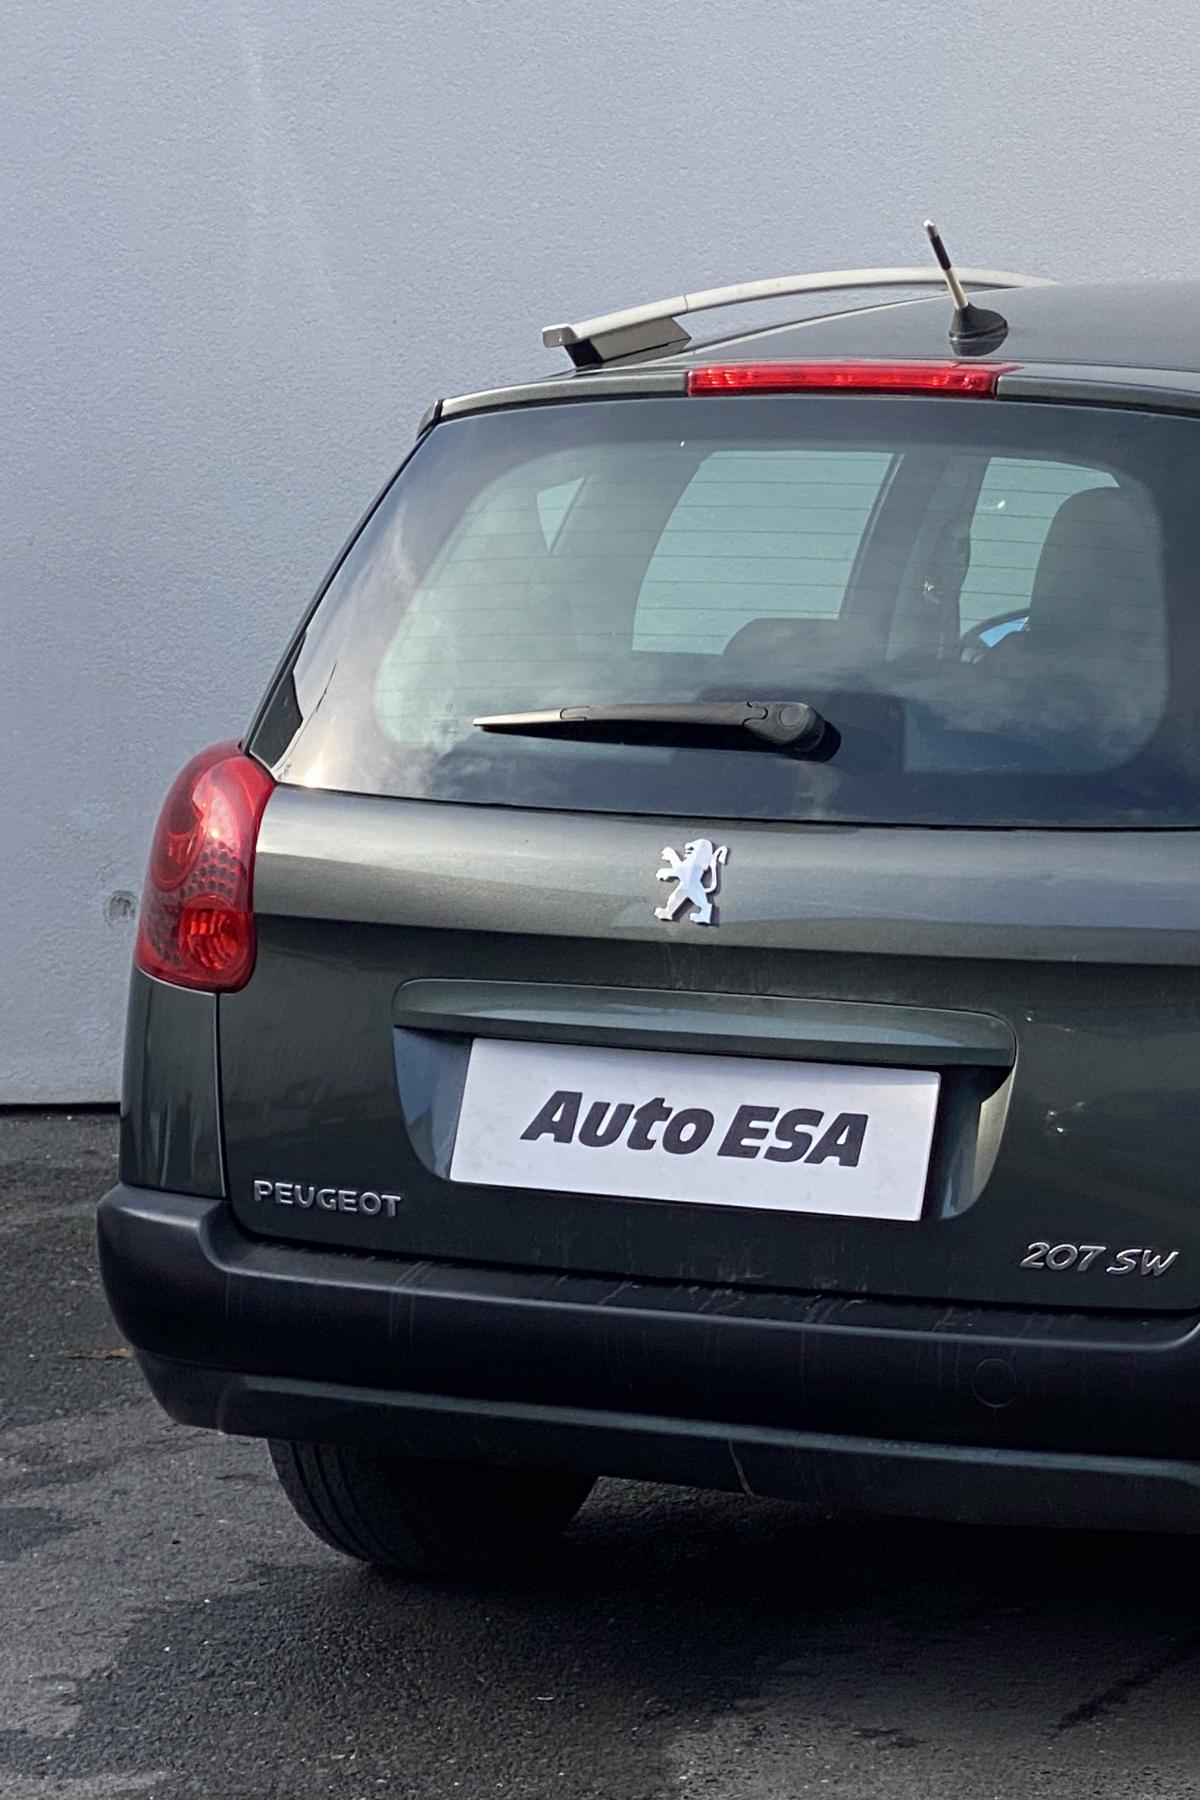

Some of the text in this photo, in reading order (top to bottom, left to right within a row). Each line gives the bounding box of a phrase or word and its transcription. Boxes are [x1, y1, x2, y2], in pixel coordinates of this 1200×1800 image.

[519, 1089, 869, 1168] Auto ESA
[253, 1179, 402, 1217] PEUGEOT
[1019, 1241, 1180, 1277] 207 SW
